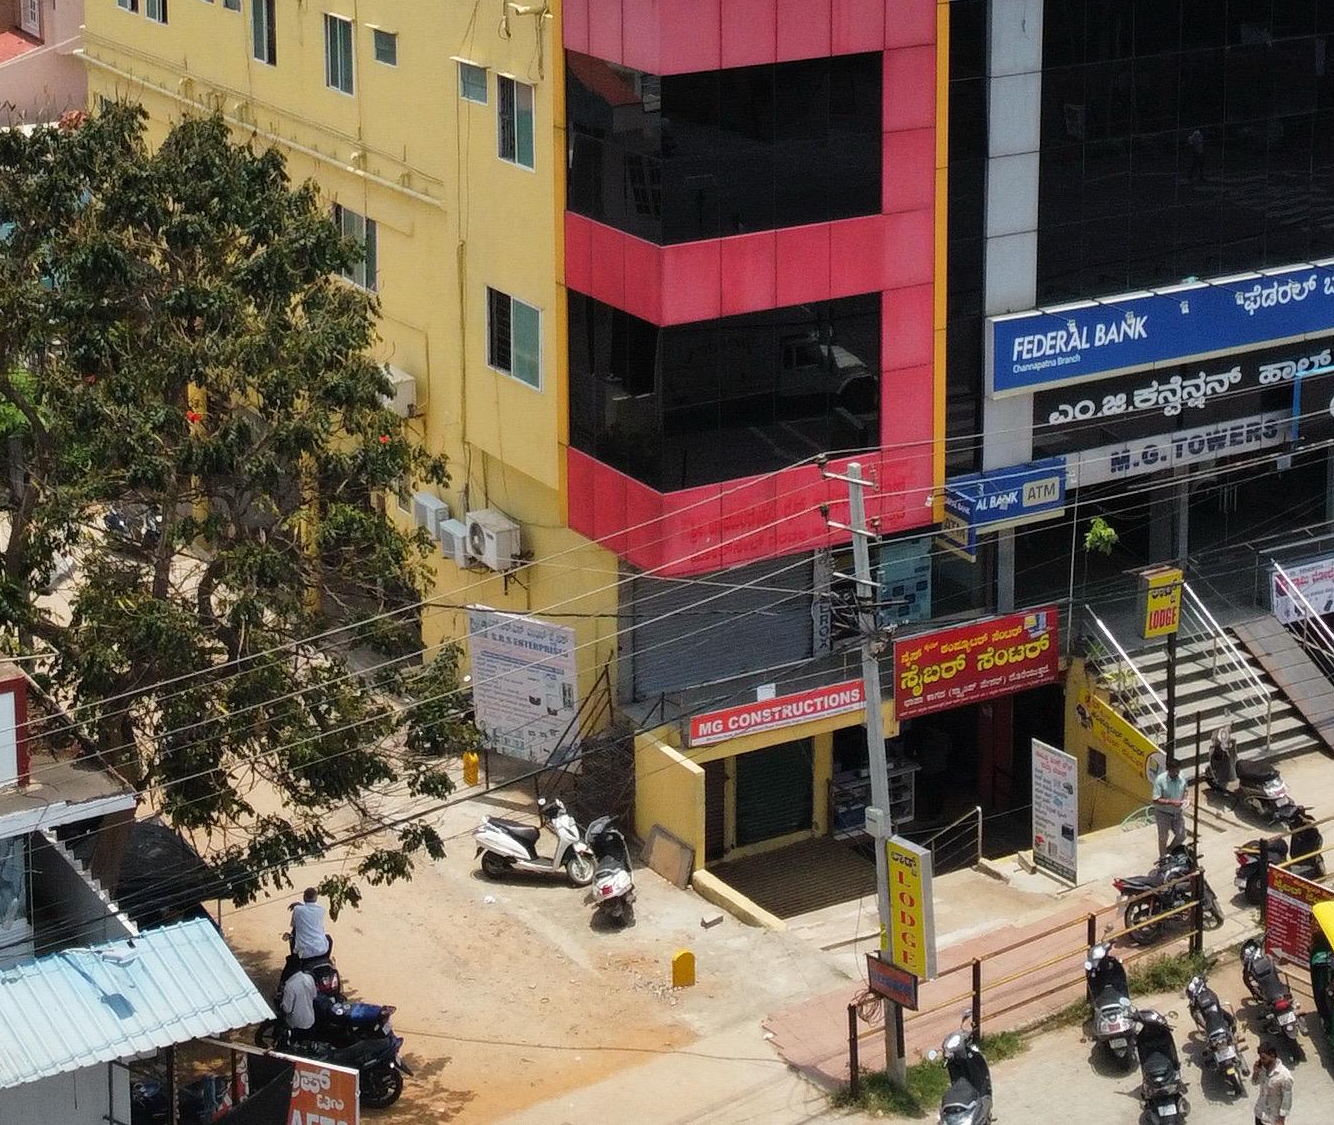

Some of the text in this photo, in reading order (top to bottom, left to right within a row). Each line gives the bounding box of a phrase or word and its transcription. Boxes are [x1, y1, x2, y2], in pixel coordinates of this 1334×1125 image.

[1013, 315, 1148, 362] FEDERAL BANK
[1013, 353, 1081, 374] Channapatna Branch
[989, 490, 1018, 510] BANK
[1028, 482, 1055, 501] ATM
[1149, 606, 1177, 631] LODGE
[977, 633, 1050, 671] ಸೆಂಟರ್
[698, 719, 723, 736] MG
[728, 689, 861, 729] CONSTRUCTIONS
[898, 870, 917, 968] LODGE
